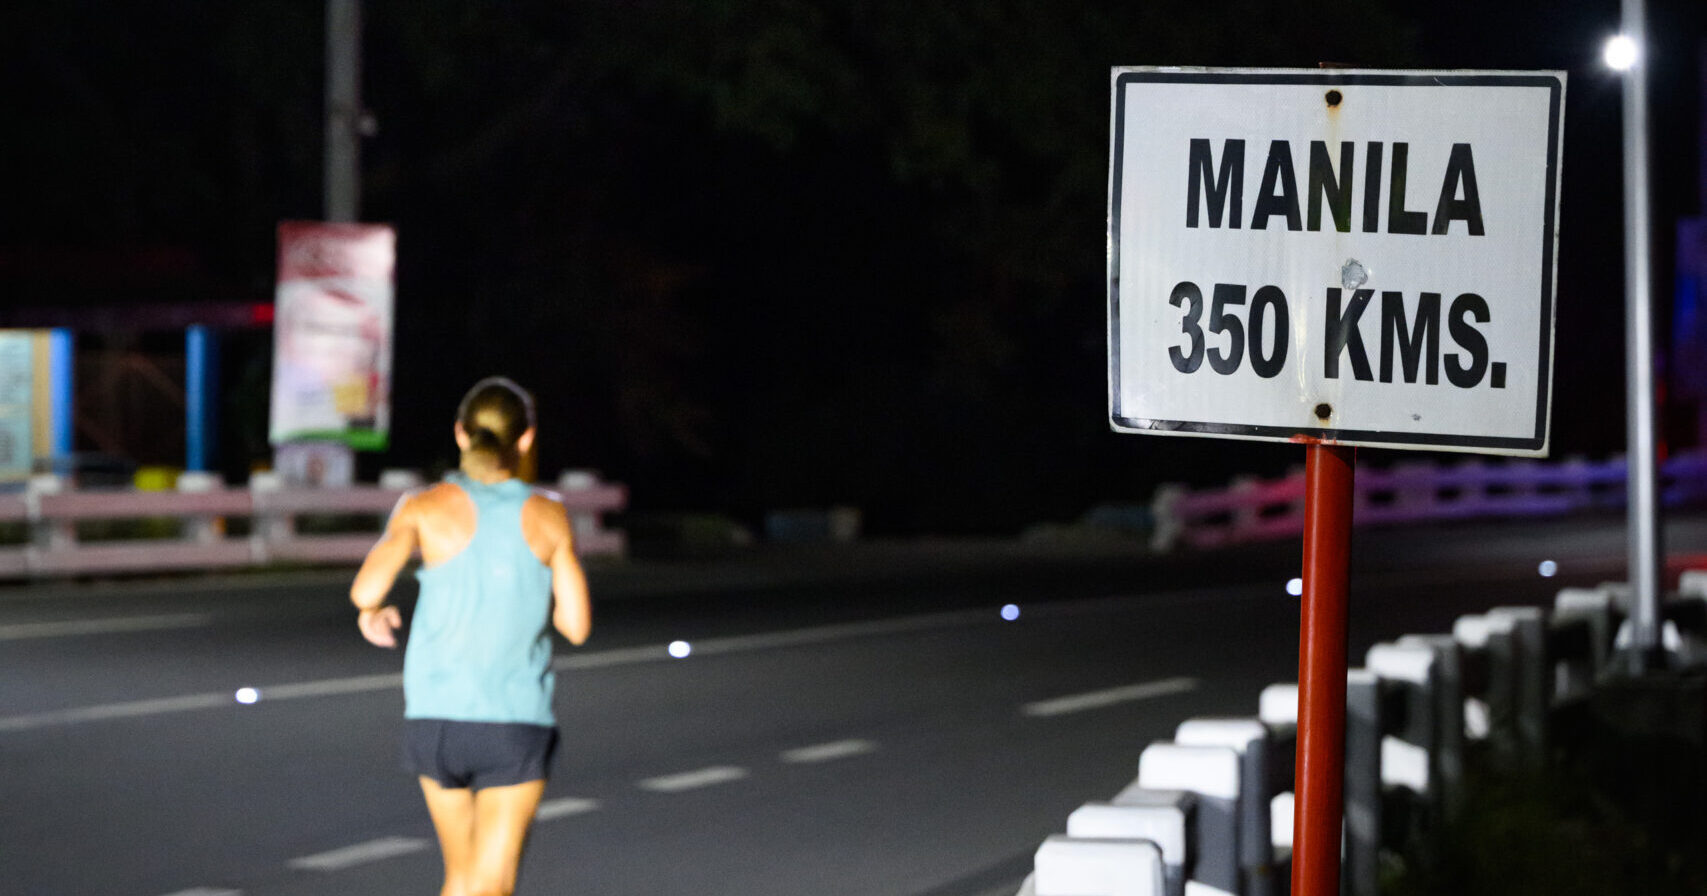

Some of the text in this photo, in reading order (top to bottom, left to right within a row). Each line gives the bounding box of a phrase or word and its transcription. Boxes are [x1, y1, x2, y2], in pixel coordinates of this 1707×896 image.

[1186, 138, 1486, 236] MANILA
[1168, 281, 1507, 389] 350 KMS.
